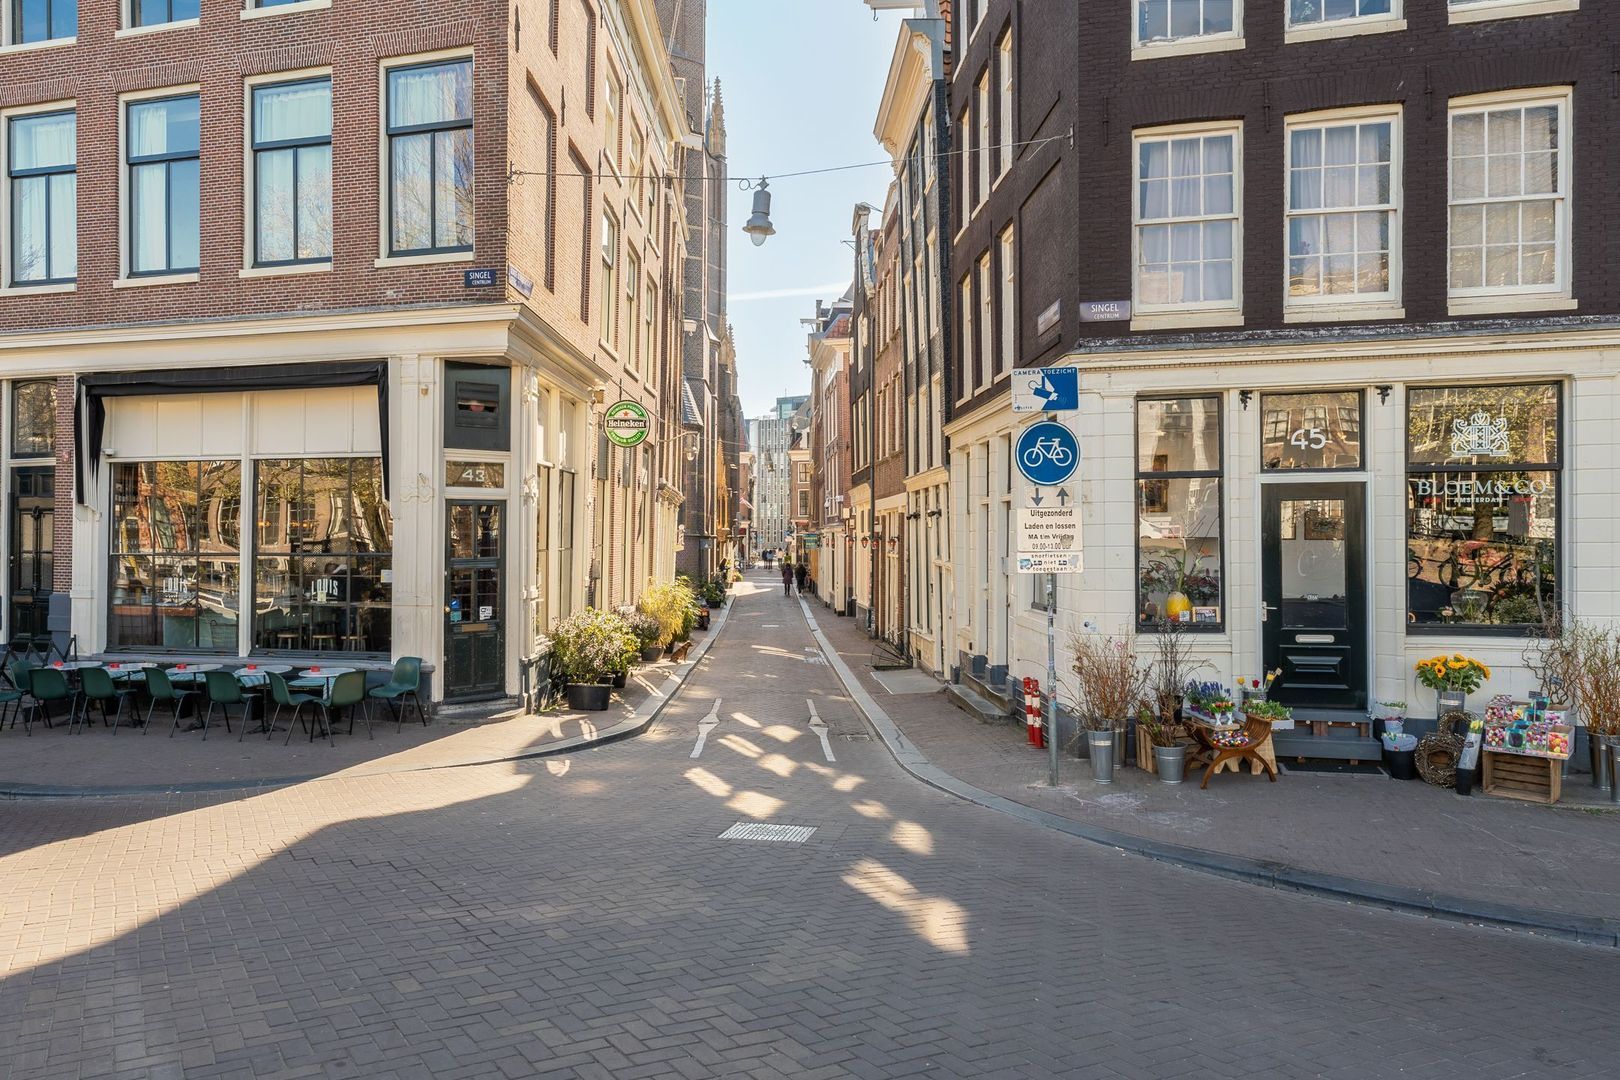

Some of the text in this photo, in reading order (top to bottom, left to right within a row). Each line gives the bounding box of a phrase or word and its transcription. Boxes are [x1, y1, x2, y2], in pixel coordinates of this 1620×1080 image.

[469, 271, 491, 279] SINGEL
[1091, 303, 1119, 313] SINGEL
[1291, 428, 1326, 450] 45
[462, 469, 486, 482] 43
[1030, 509, 1073, 518] Uitgezonderd
[162, 577, 188, 594] LOUIS
[311, 578, 339, 596] LOUIS
